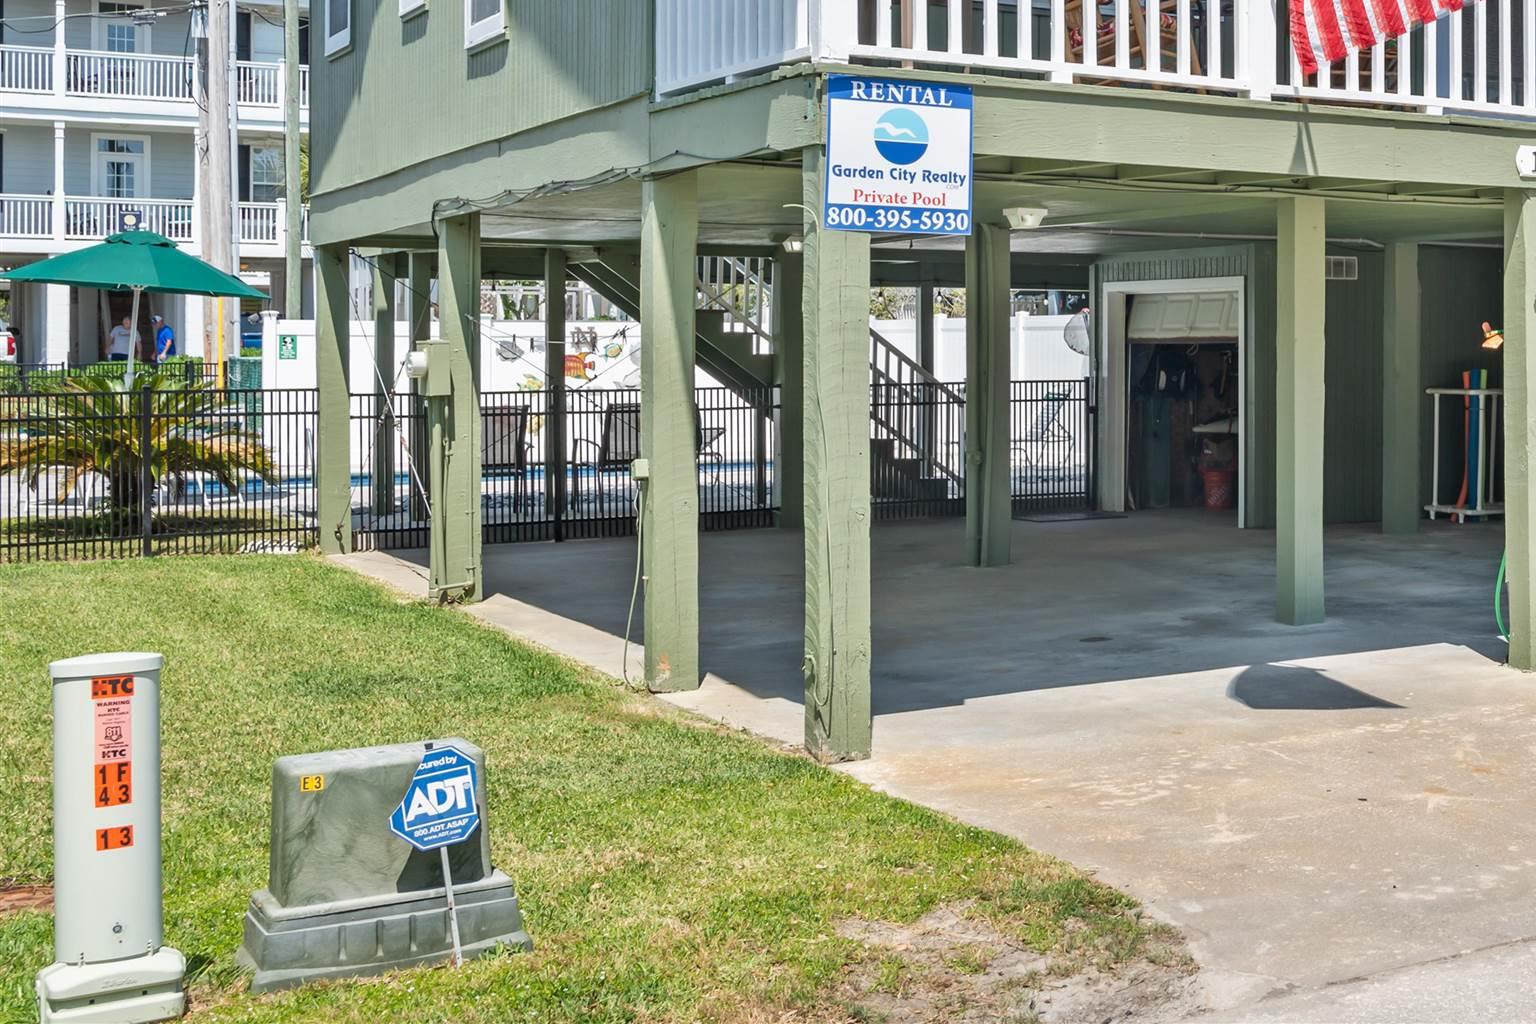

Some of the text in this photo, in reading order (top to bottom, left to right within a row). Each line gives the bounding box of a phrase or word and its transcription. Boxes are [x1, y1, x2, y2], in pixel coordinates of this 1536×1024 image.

[850, 80, 953, 107] RENTAL
[832, 164, 967, 188] Garden City Realty
[853, 189, 947, 207] Private Pool
[827, 207, 969, 230] 800-395-5930
[445, 756, 457, 765] by
[406, 775, 470, 822] ADT
